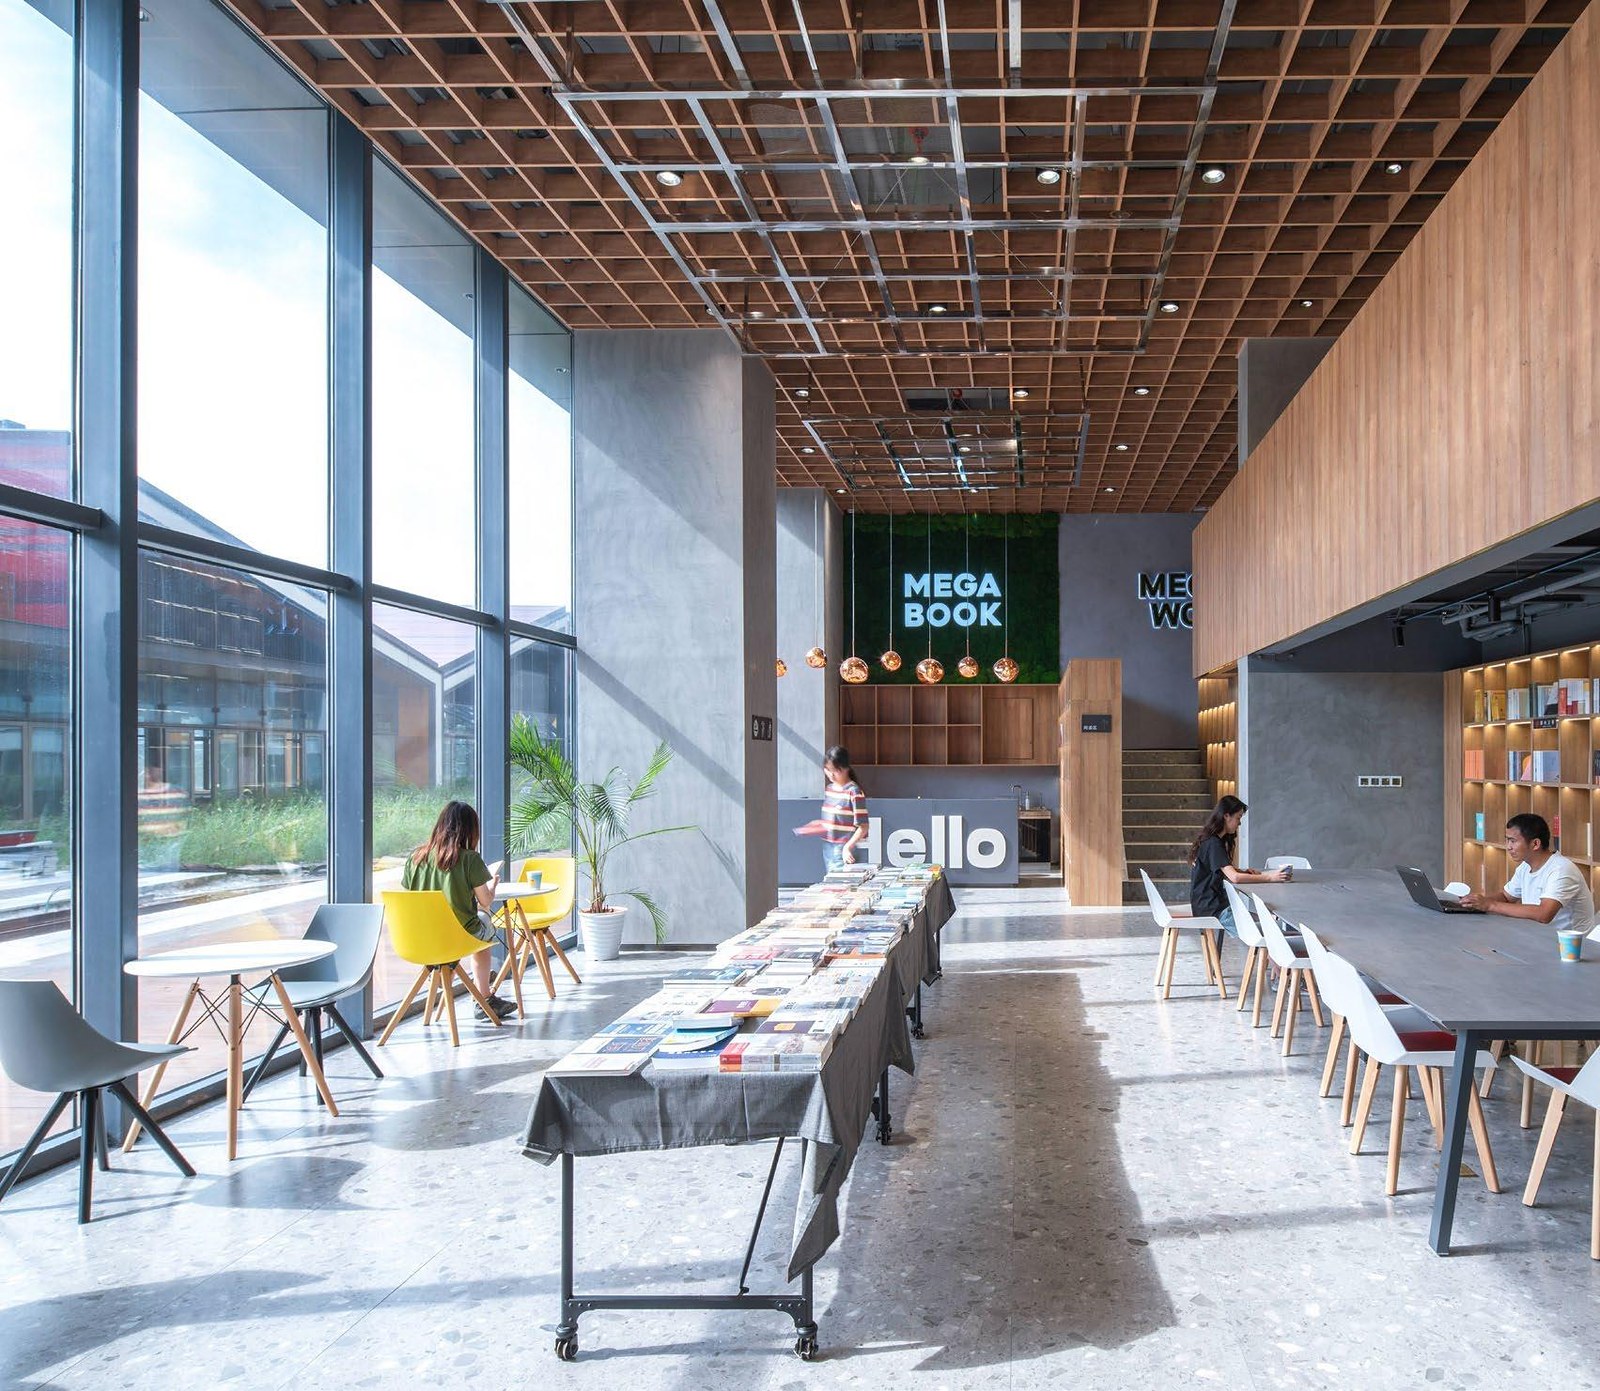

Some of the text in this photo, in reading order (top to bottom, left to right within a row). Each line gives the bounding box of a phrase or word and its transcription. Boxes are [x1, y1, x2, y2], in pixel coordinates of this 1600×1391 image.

[904, 573, 1002, 598] MEGA
[1137, 571, 1193, 600] ME
[904, 602, 1003, 628] BOOK
